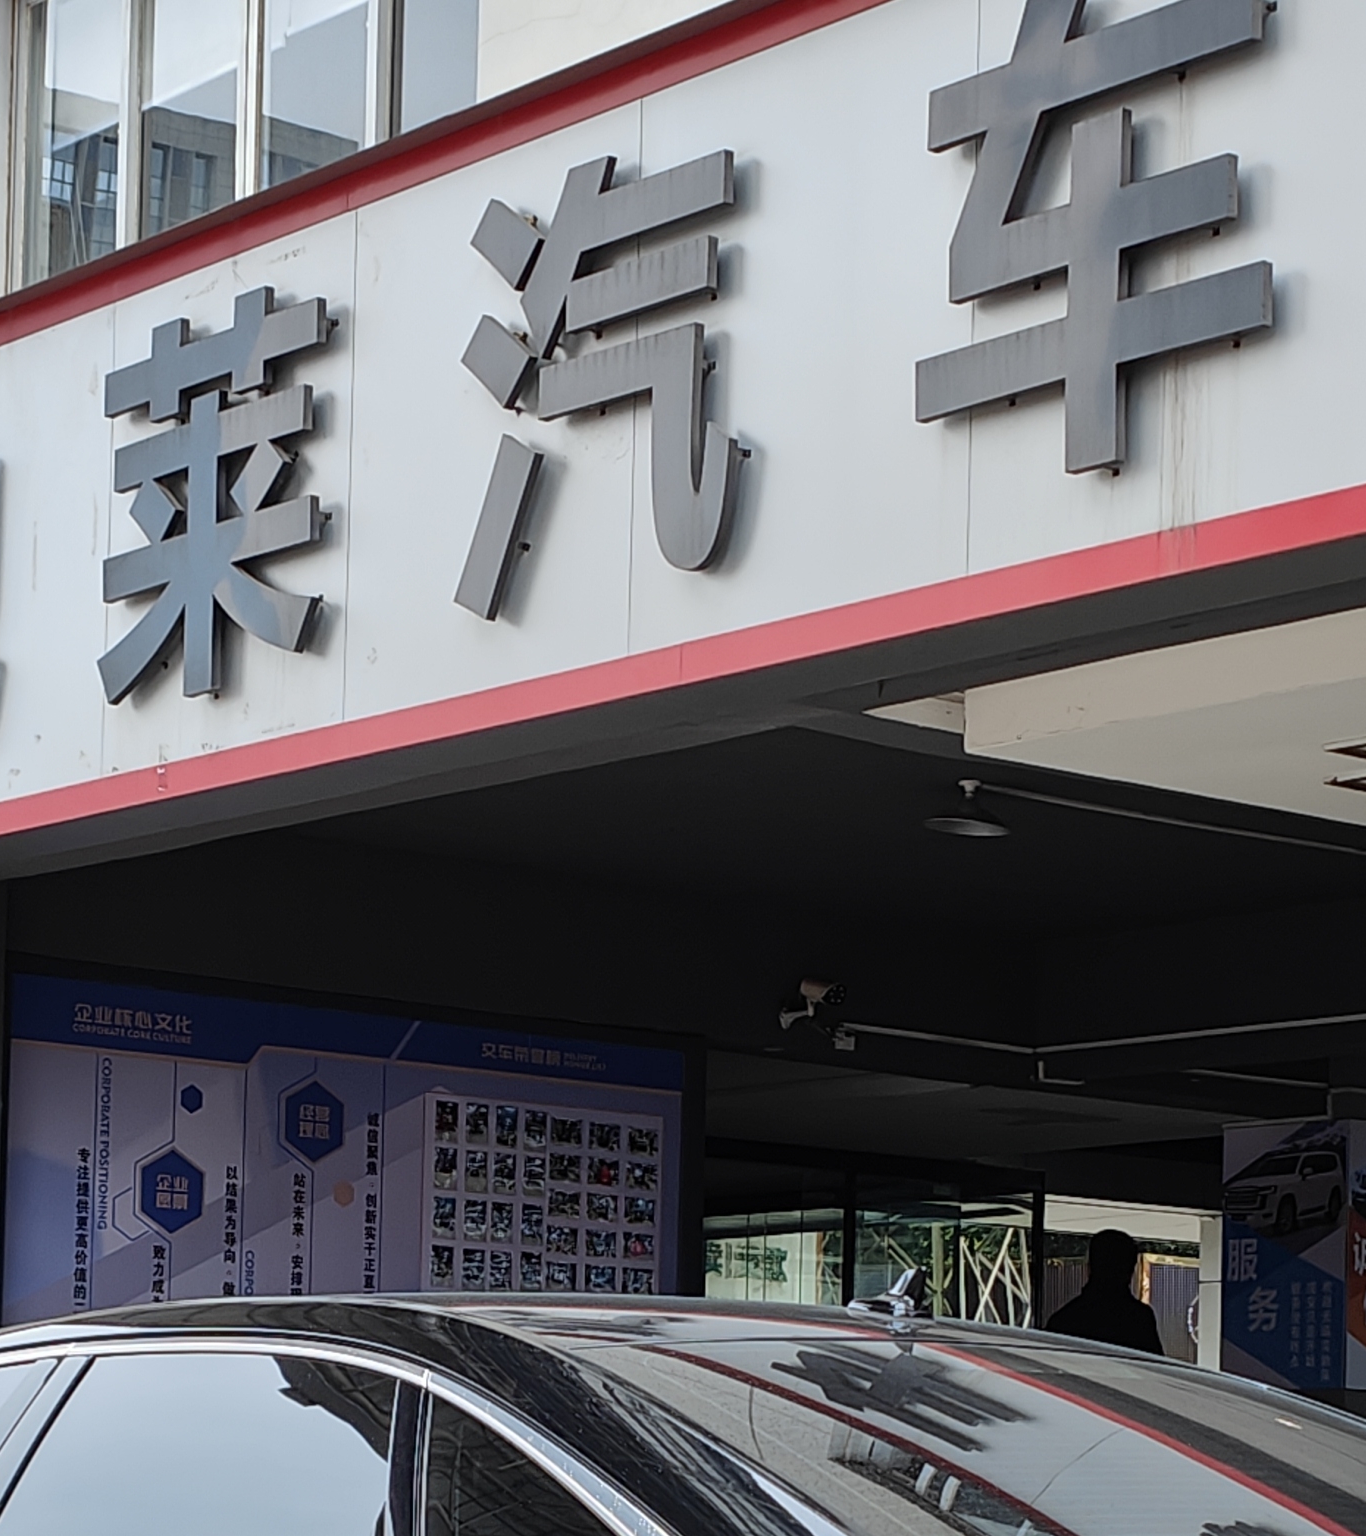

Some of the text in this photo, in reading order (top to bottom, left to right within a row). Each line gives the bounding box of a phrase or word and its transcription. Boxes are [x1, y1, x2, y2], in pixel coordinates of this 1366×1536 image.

[73, 1003, 193, 1036] 企业核心文化
[96, 1057, 113, 1230] CORPORATE POSITIONING
[72, 1147, 91, 1314] 专注提供更高价值的一
[1225, 1237, 1280, 1334] 服务
